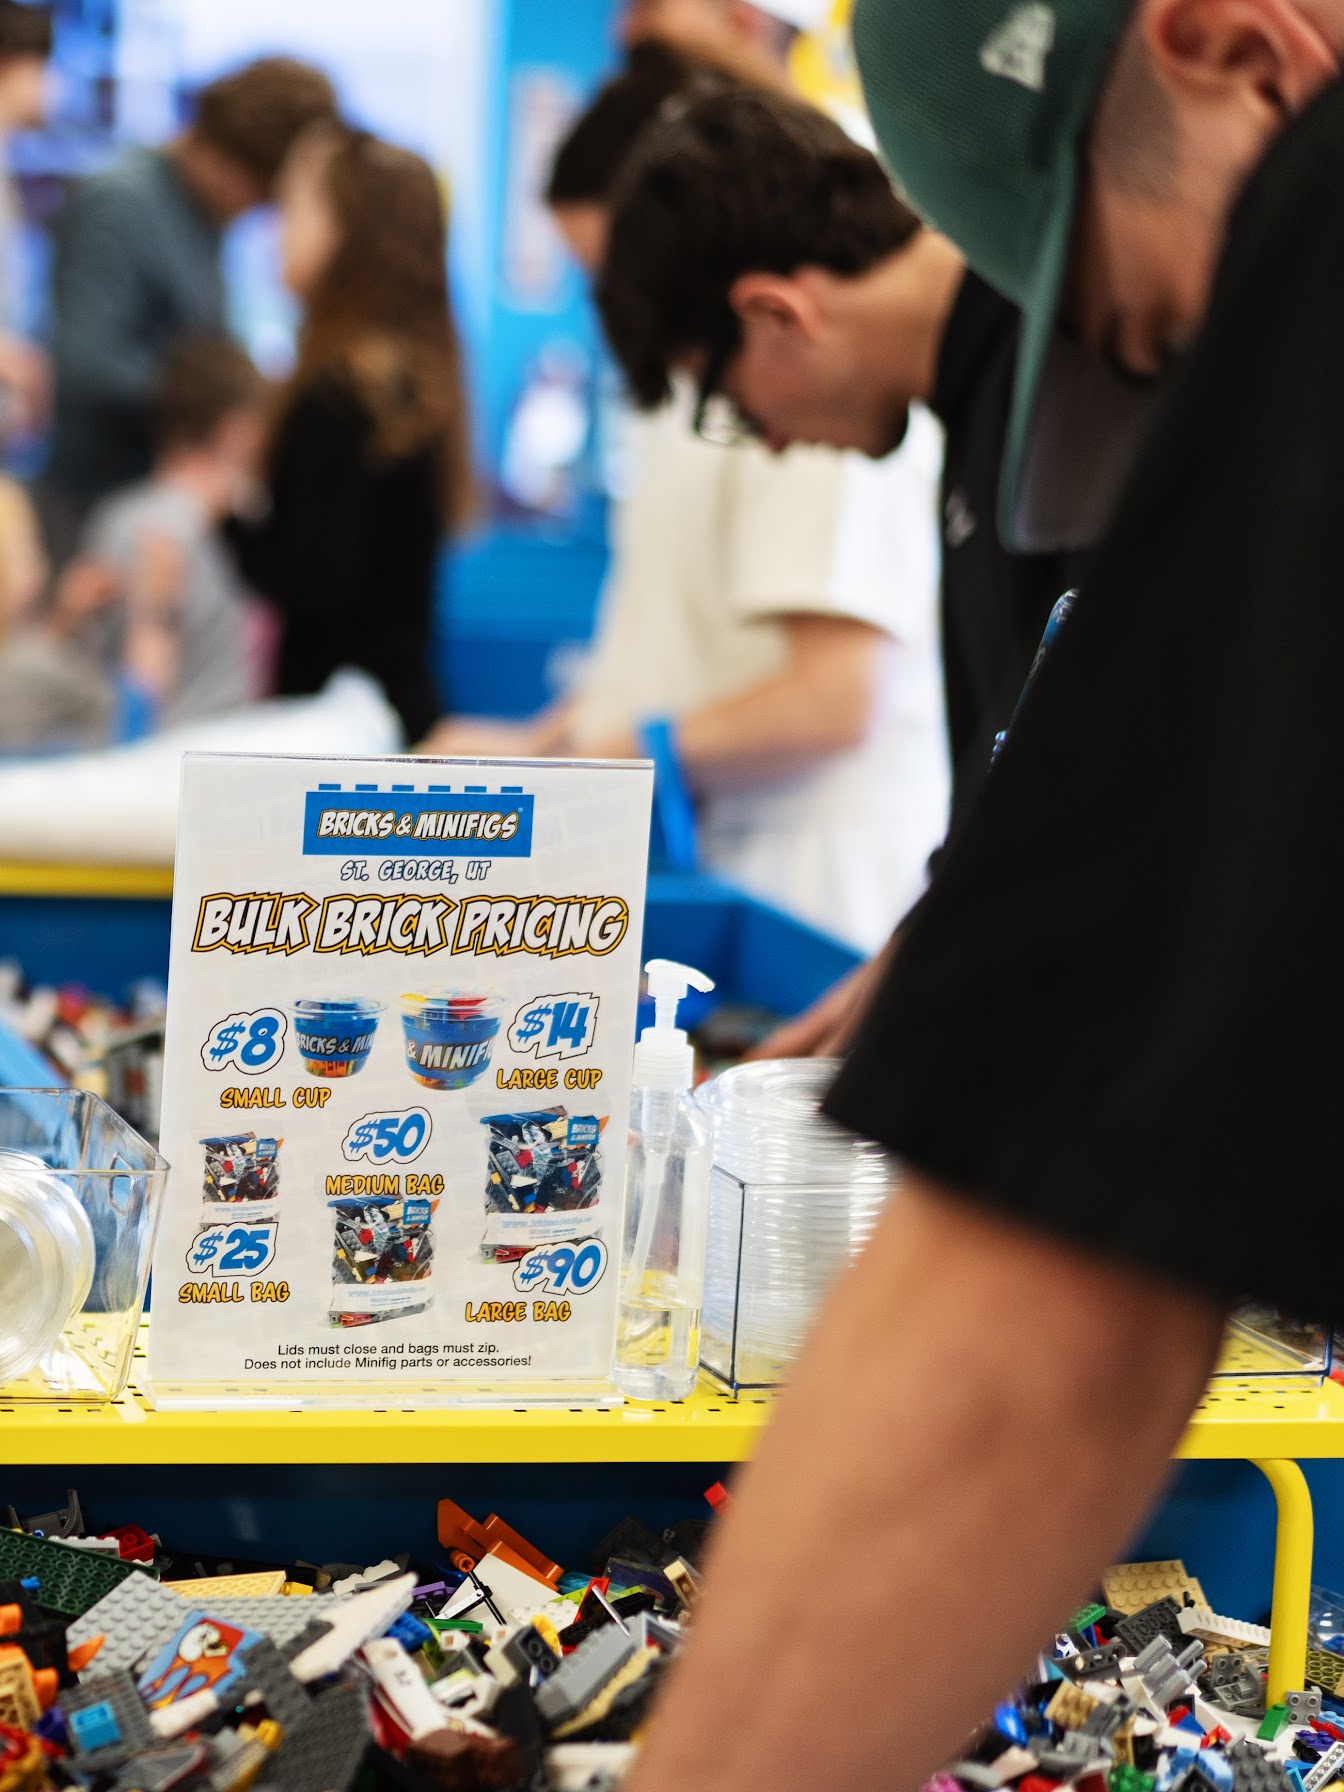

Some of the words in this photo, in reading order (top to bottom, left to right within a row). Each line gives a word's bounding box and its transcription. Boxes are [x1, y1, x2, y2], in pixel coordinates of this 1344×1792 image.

[317, 809, 395, 838] BRICKS
[395, 814, 413, 838] &
[412, 811, 519, 841] MINIFIGS
[340, 860, 369, 881] ST.
[378, 860, 459, 884] GEORGE,
[465, 861, 491, 881] UT
[191, 892, 320, 956] BULK
[313, 893, 458, 957] BRICK
[450, 894, 629, 959] PRICING
[516, 1001, 590, 1049] $14
[209, 1016, 279, 1066] $8
[295, 1032, 338, 1055] BRICKS
[337, 1036, 351, 1054] &
[406, 1039, 418, 1062] &
[496, 1068, 558, 1089] LARGE
[564, 1068, 603, 1089] CUP
[220, 1087, 286, 1109] SMALL
[292, 1087, 332, 1109] CUP
[349, 1113, 426, 1158] $50
[325, 1174, 400, 1196] MEDIUM
[405, 1174, 444, 1195] BAG
[193, 1228, 271, 1270] $25
[519, 1244, 602, 1288] $90
[178, 1281, 244, 1303] SMALL
[250, 1281, 291, 1303] BAG
[465, 1301, 527, 1323] LARGE
[532, 1301, 572, 1322] BAG
[278, 1344, 304, 1355] Lids
[308, 1345, 340, 1355] must
[343, 1344, 377, 1355] close
[380, 1343, 404, 1354] and
[408, 1343, 439, 1356] bags
[443, 1343, 474, 1353] must
[477, 1342, 499, 1355] zip.
[244, 1358, 277, 1369] Does
[280, 1359, 301, 1369] not
[305, 1357, 351, 1369] include
[355, 1356, 397, 1370] Minifig
[400, 1357, 433, 1369] parts
[436, 1358, 449, 1367] or
[453, 1355, 531, 1367] accessories!
